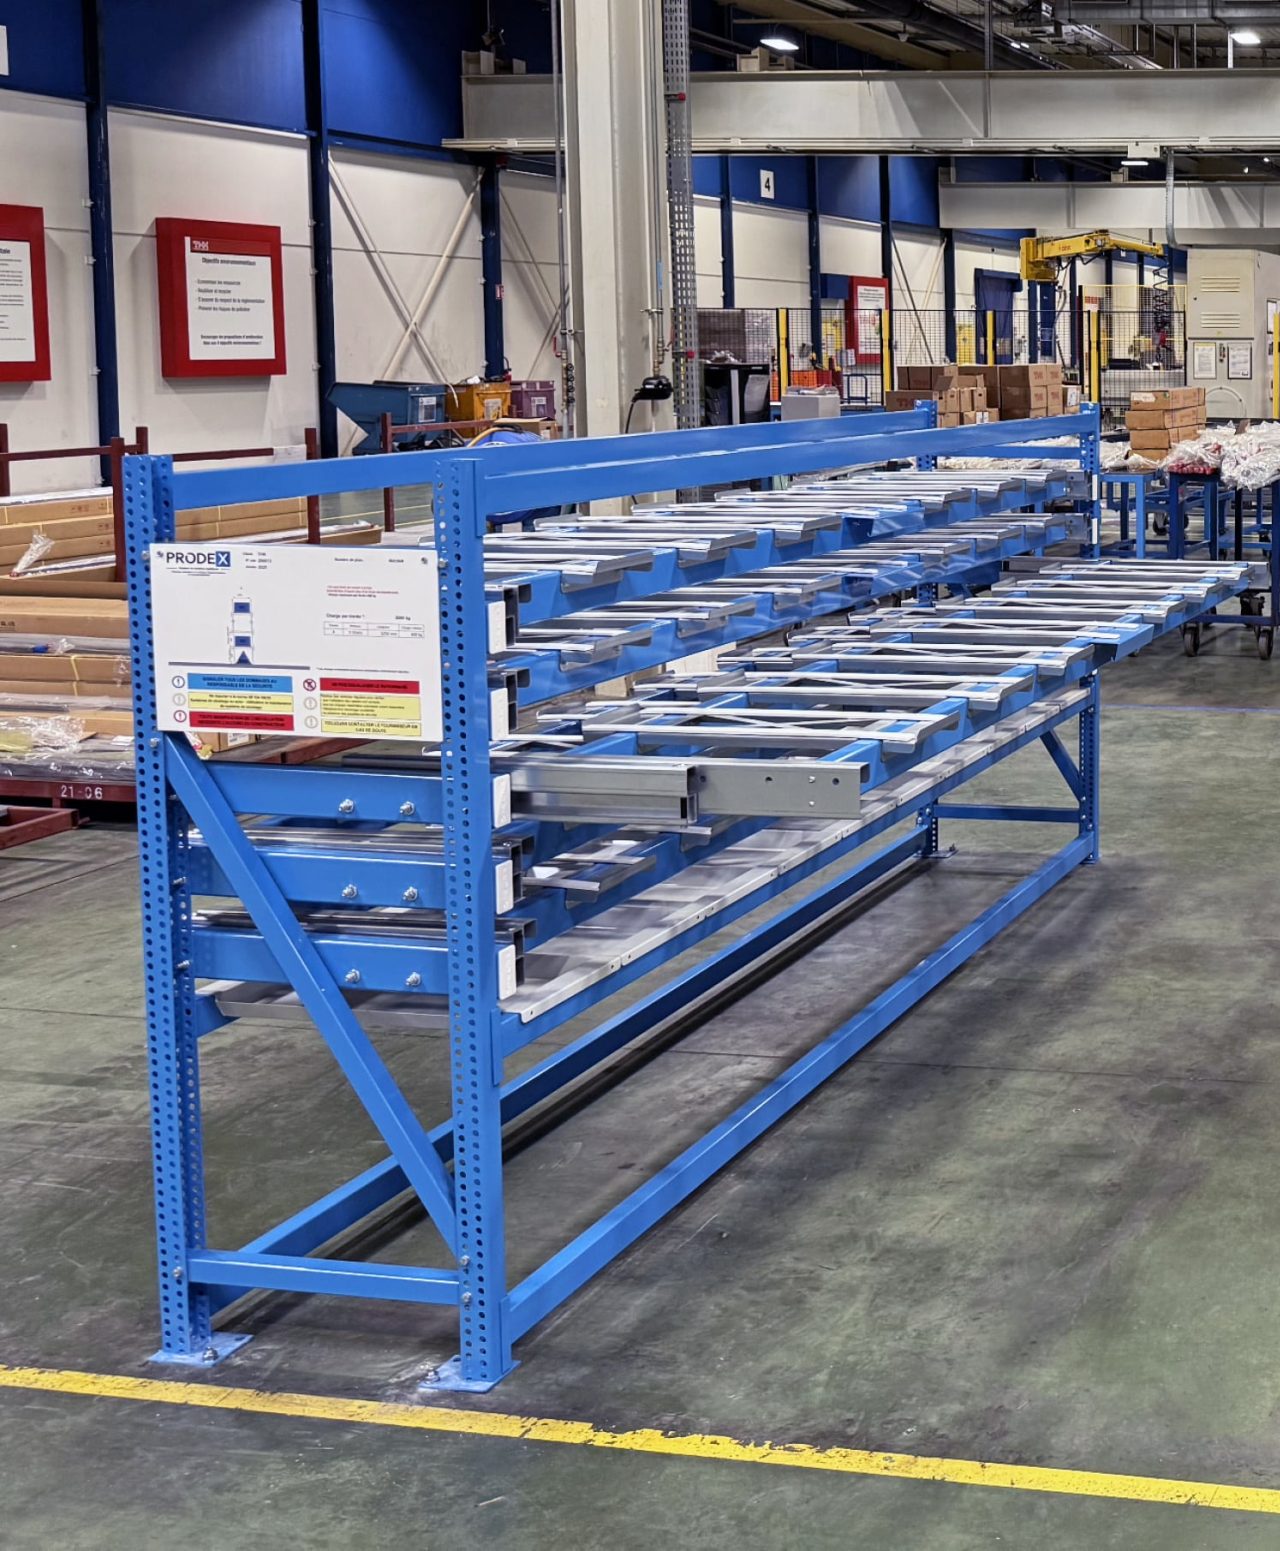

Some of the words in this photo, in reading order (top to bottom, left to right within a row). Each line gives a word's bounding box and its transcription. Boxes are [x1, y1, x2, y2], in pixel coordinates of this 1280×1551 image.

[764, 177, 771, 192] 4
[192, 241, 209, 251] THK
[166, 551, 230, 566] PRODEX
